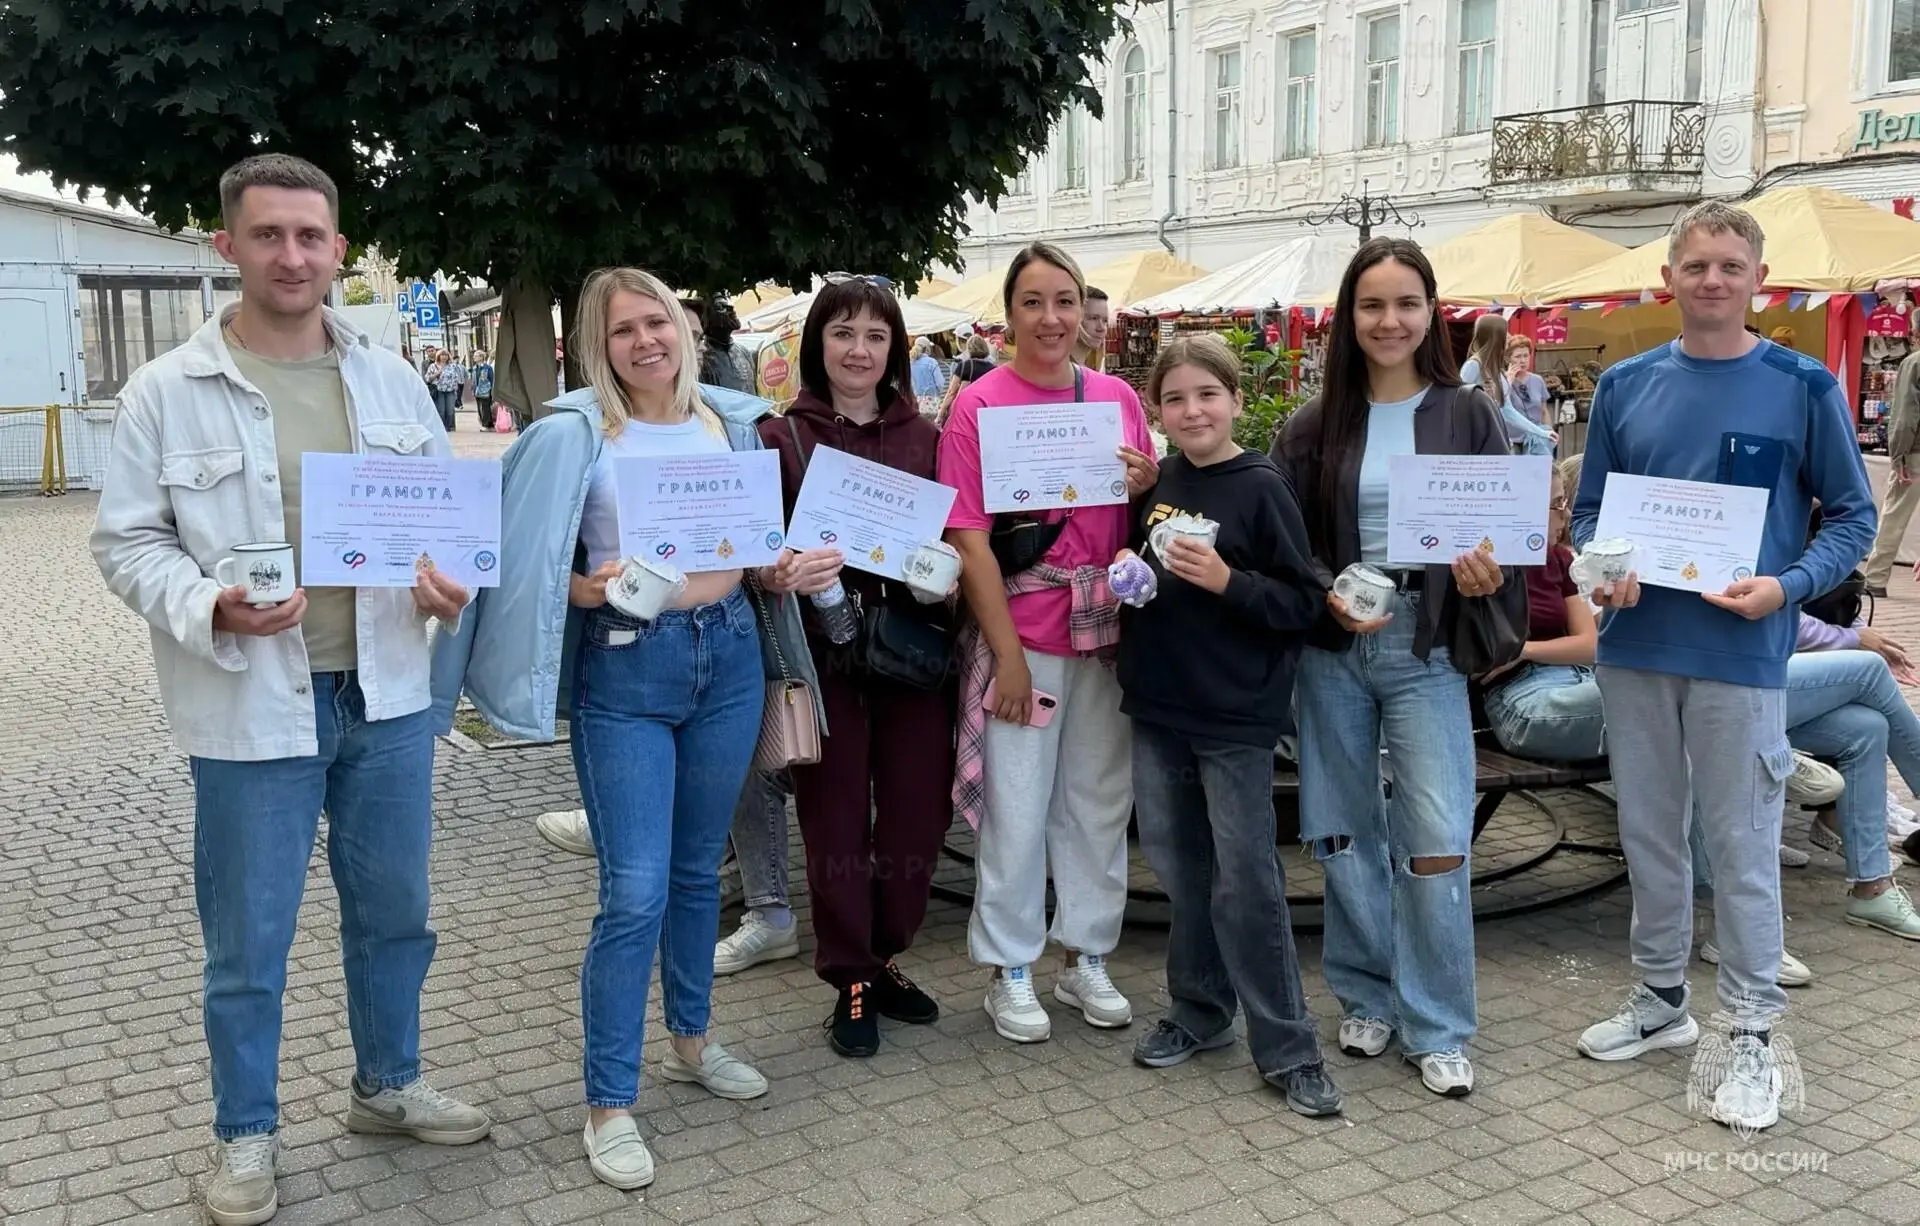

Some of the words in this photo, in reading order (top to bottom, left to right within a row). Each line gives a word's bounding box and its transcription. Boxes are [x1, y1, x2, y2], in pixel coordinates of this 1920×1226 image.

[1854, 108, 1920, 153] Дел
[421, 309, 434, 326] P
[1015, 426, 1089, 441] ГРАМОТА
[351, 484, 453, 501] ГРАМОТА
[657, 478, 744, 495] ГРАМОТА
[841, 478, 916, 511] ГРАМОТА
[1428, 480, 1512, 492] ГРАМОТА
[1640, 501, 1725, 522] ГРАМОТА
